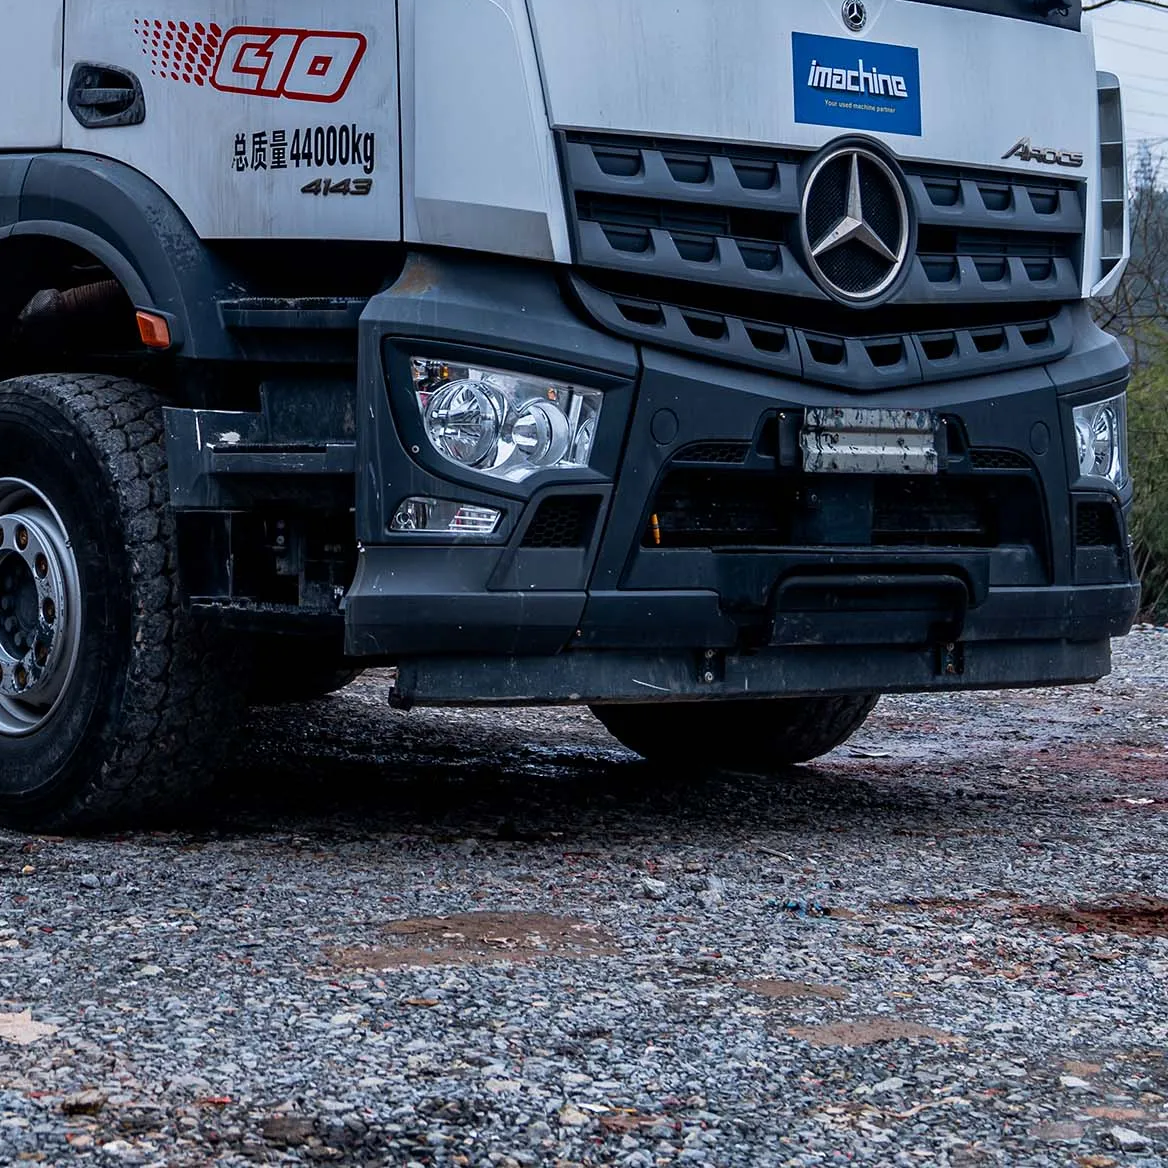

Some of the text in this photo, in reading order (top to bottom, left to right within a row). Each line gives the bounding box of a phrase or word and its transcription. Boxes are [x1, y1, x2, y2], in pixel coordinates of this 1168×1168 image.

[211, 26, 367, 103] C10
[807, 58, 909, 98] imachine
[853, 103, 876, 111] machine
[300, 177, 373, 196] 4143
